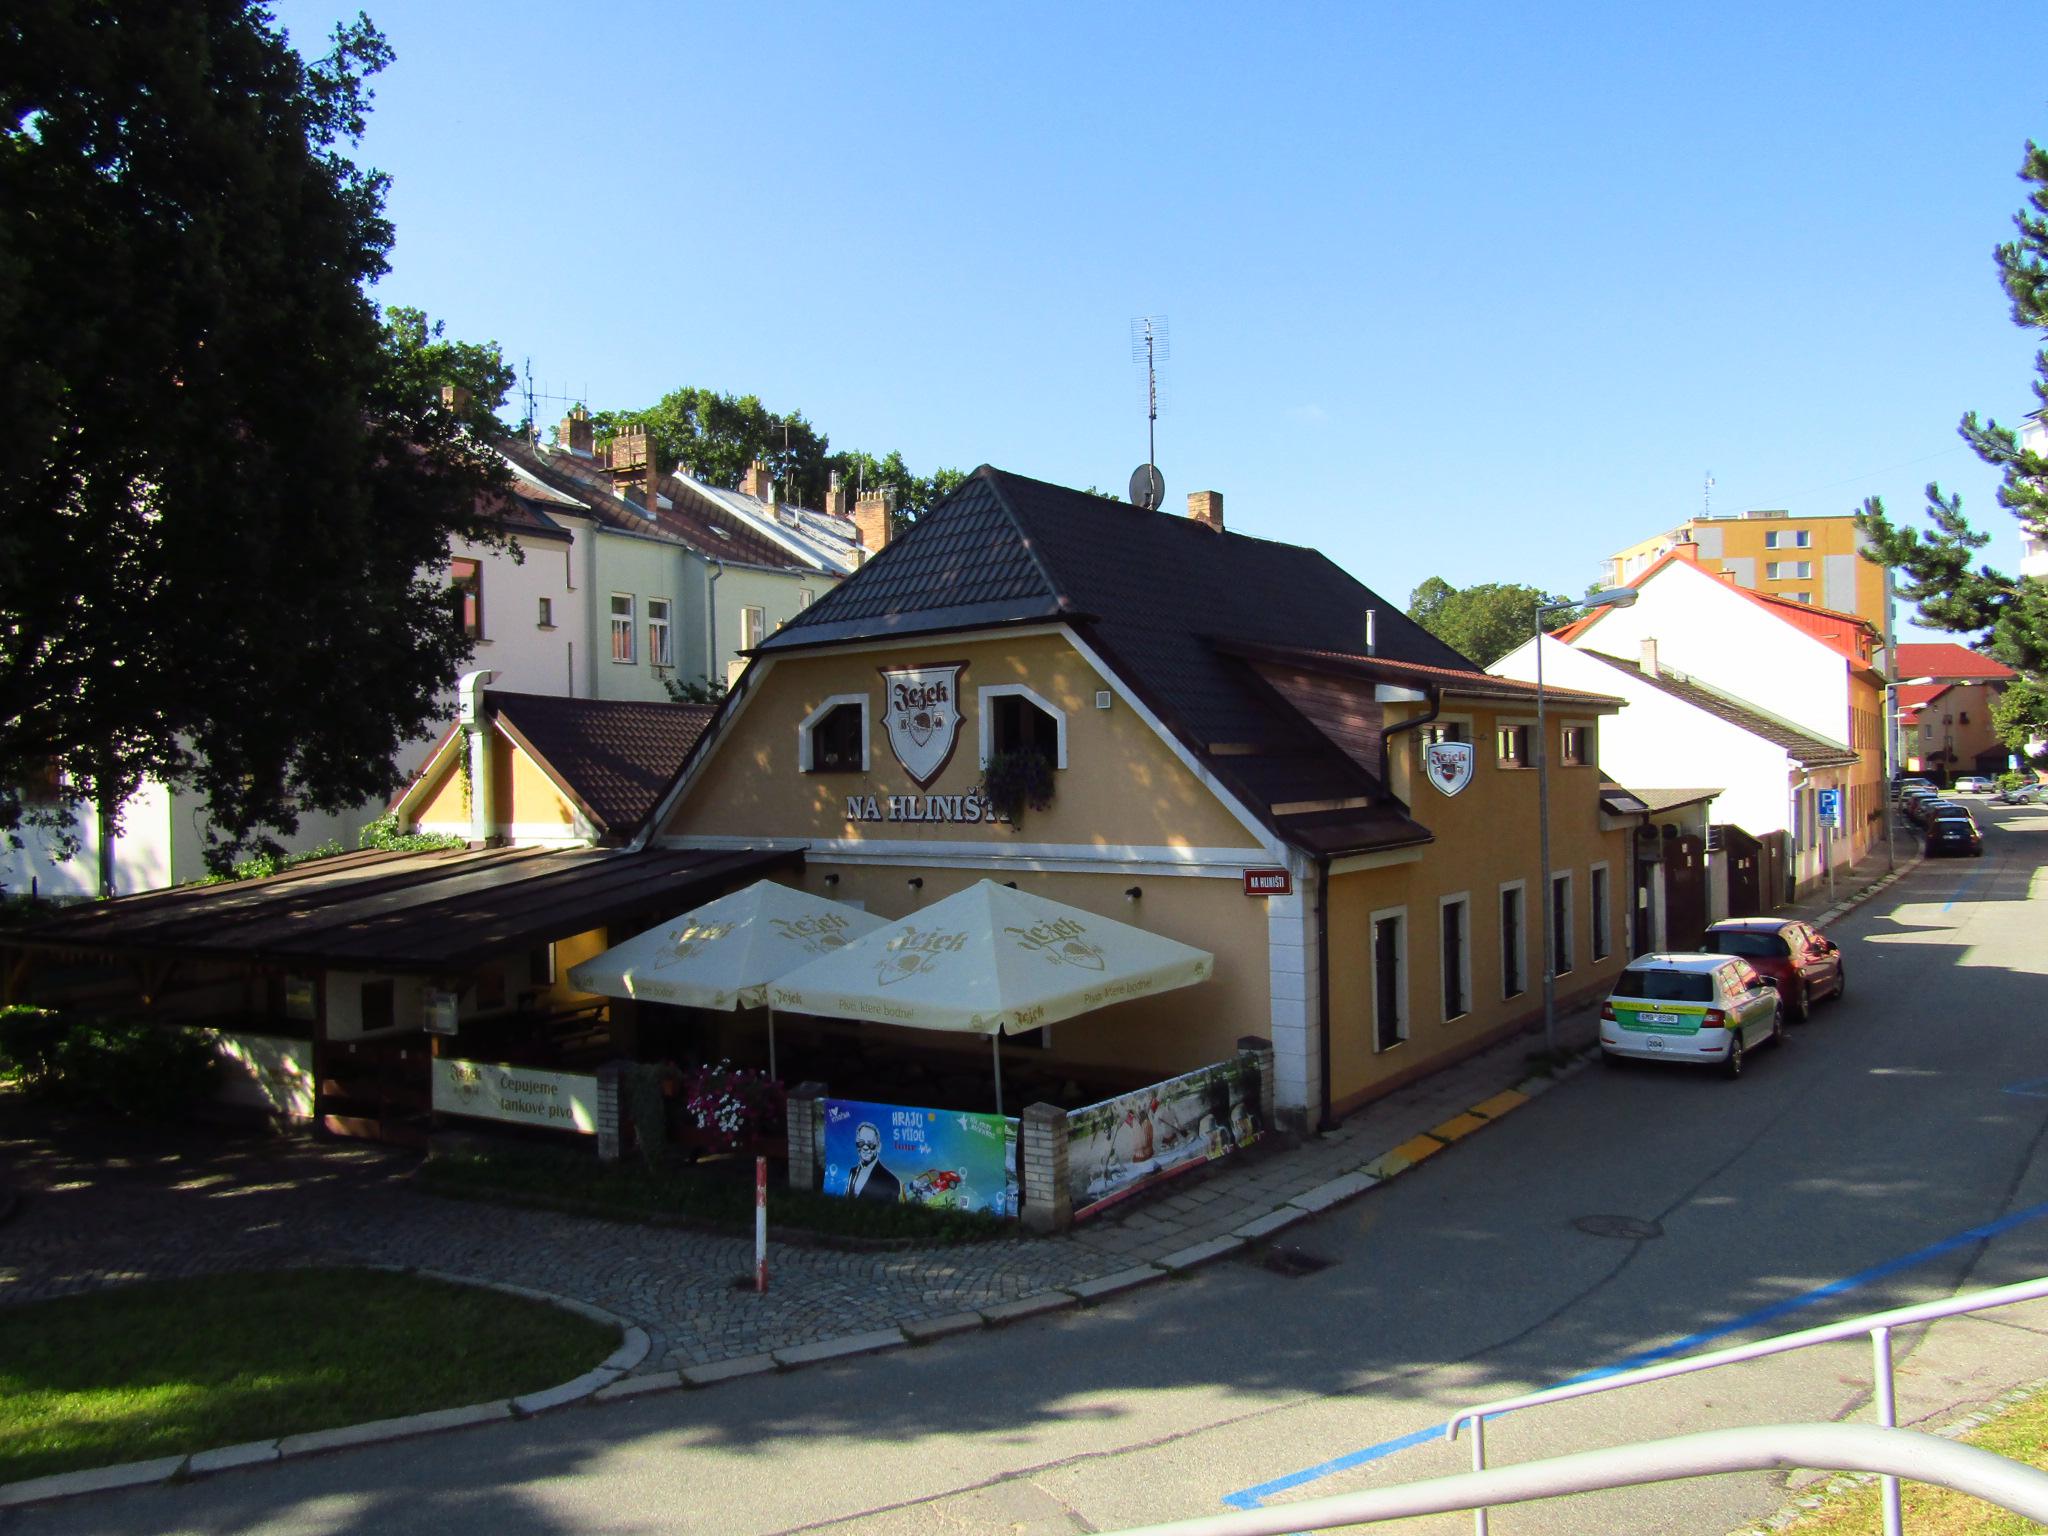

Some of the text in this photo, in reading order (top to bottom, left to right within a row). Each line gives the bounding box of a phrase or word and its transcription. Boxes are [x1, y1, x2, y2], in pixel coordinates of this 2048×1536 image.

[847, 786, 1010, 823] NA HLINIŠT
[1250, 876, 1260, 888] NA
[501, 1076, 558, 1096] Čepujeme
[892, 1111, 924, 1128] HRAJU
